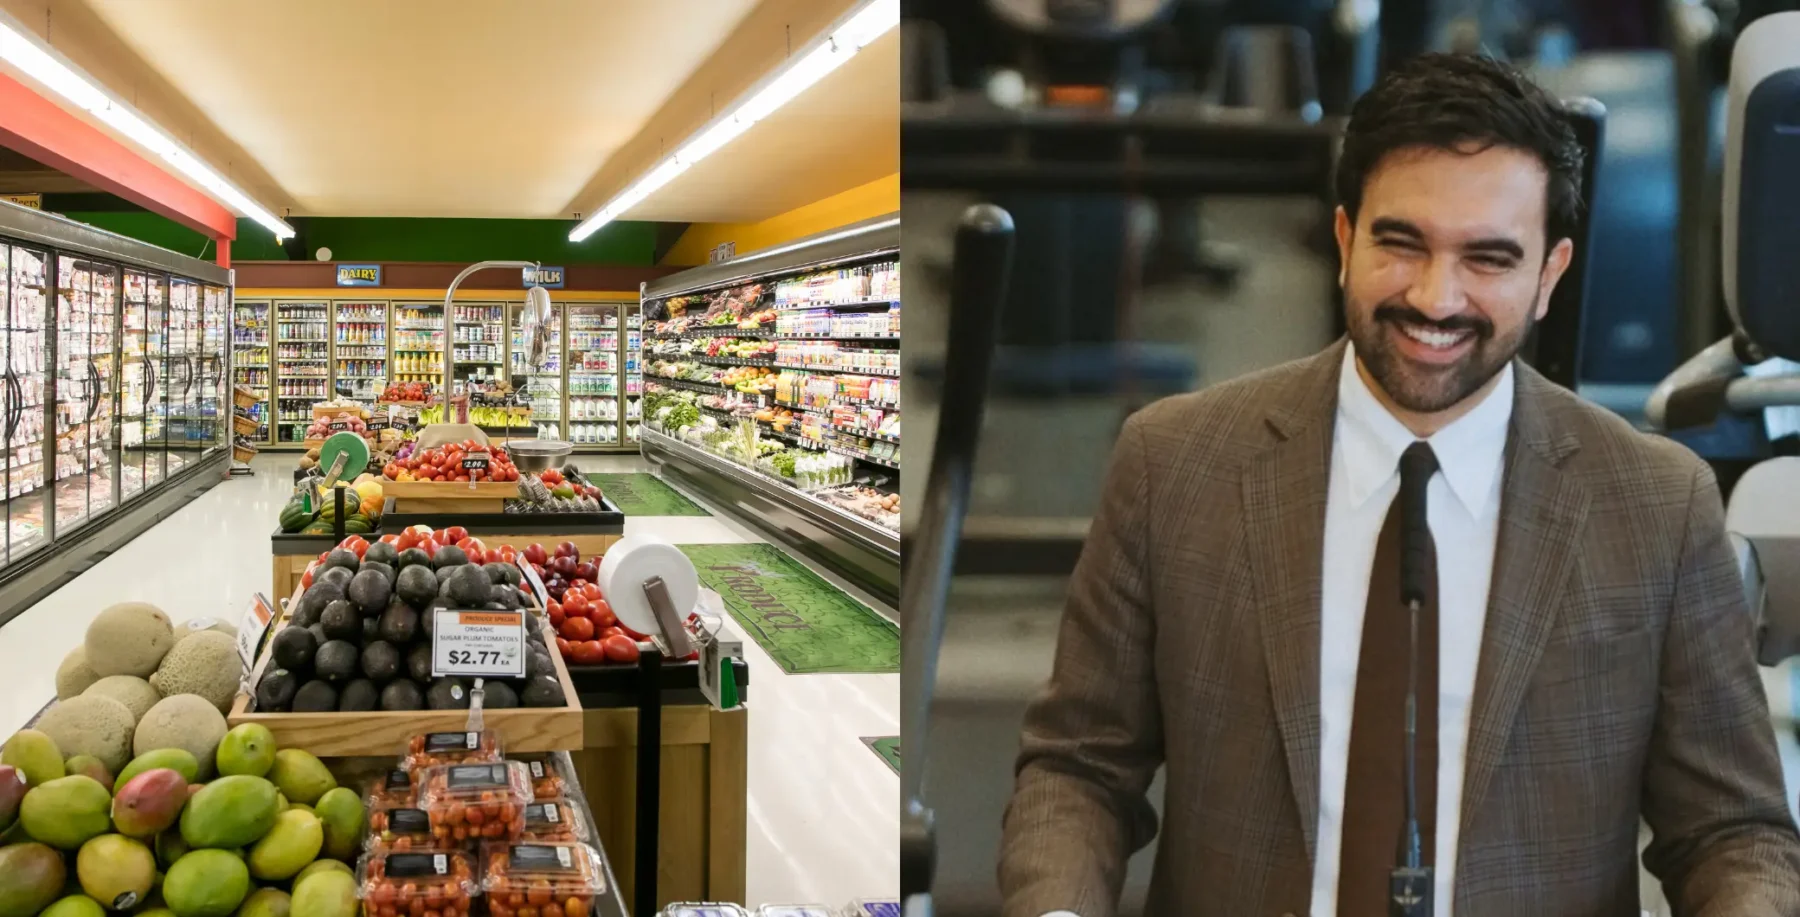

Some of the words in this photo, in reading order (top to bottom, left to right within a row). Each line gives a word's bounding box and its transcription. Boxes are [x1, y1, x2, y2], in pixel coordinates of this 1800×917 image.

[340, 268, 377, 281] DAIRY
[525, 270, 561, 284] MILK
[448, 650, 501, 665] $2.77
